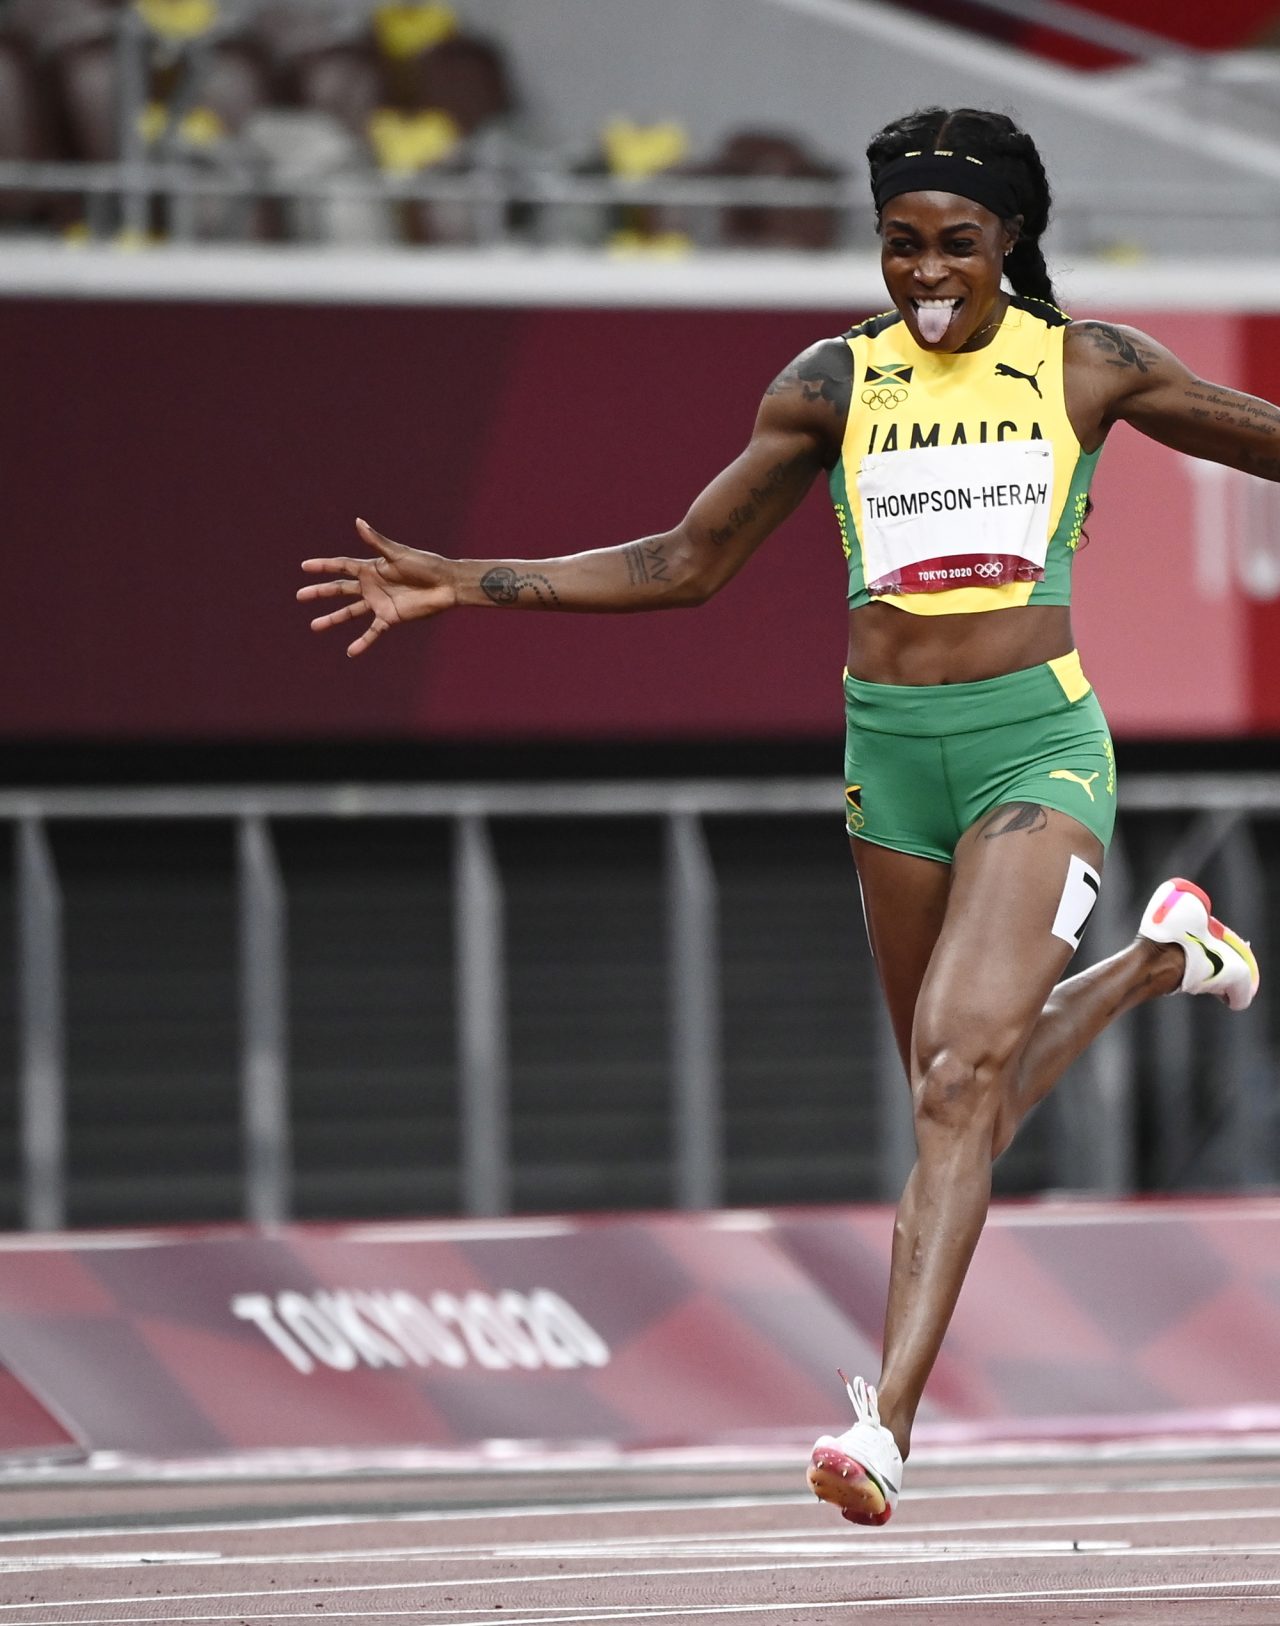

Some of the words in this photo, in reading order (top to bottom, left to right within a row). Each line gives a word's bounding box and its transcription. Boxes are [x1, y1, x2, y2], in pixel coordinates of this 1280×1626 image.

[867, 483, 1047, 519] THOMPSON-HERAH
[918, 569, 947, 582] TOKYO
[949, 567, 972, 579] 2020
[231, 1292, 467, 1374] TOKYO
[432, 1288, 611, 1369] 2020
